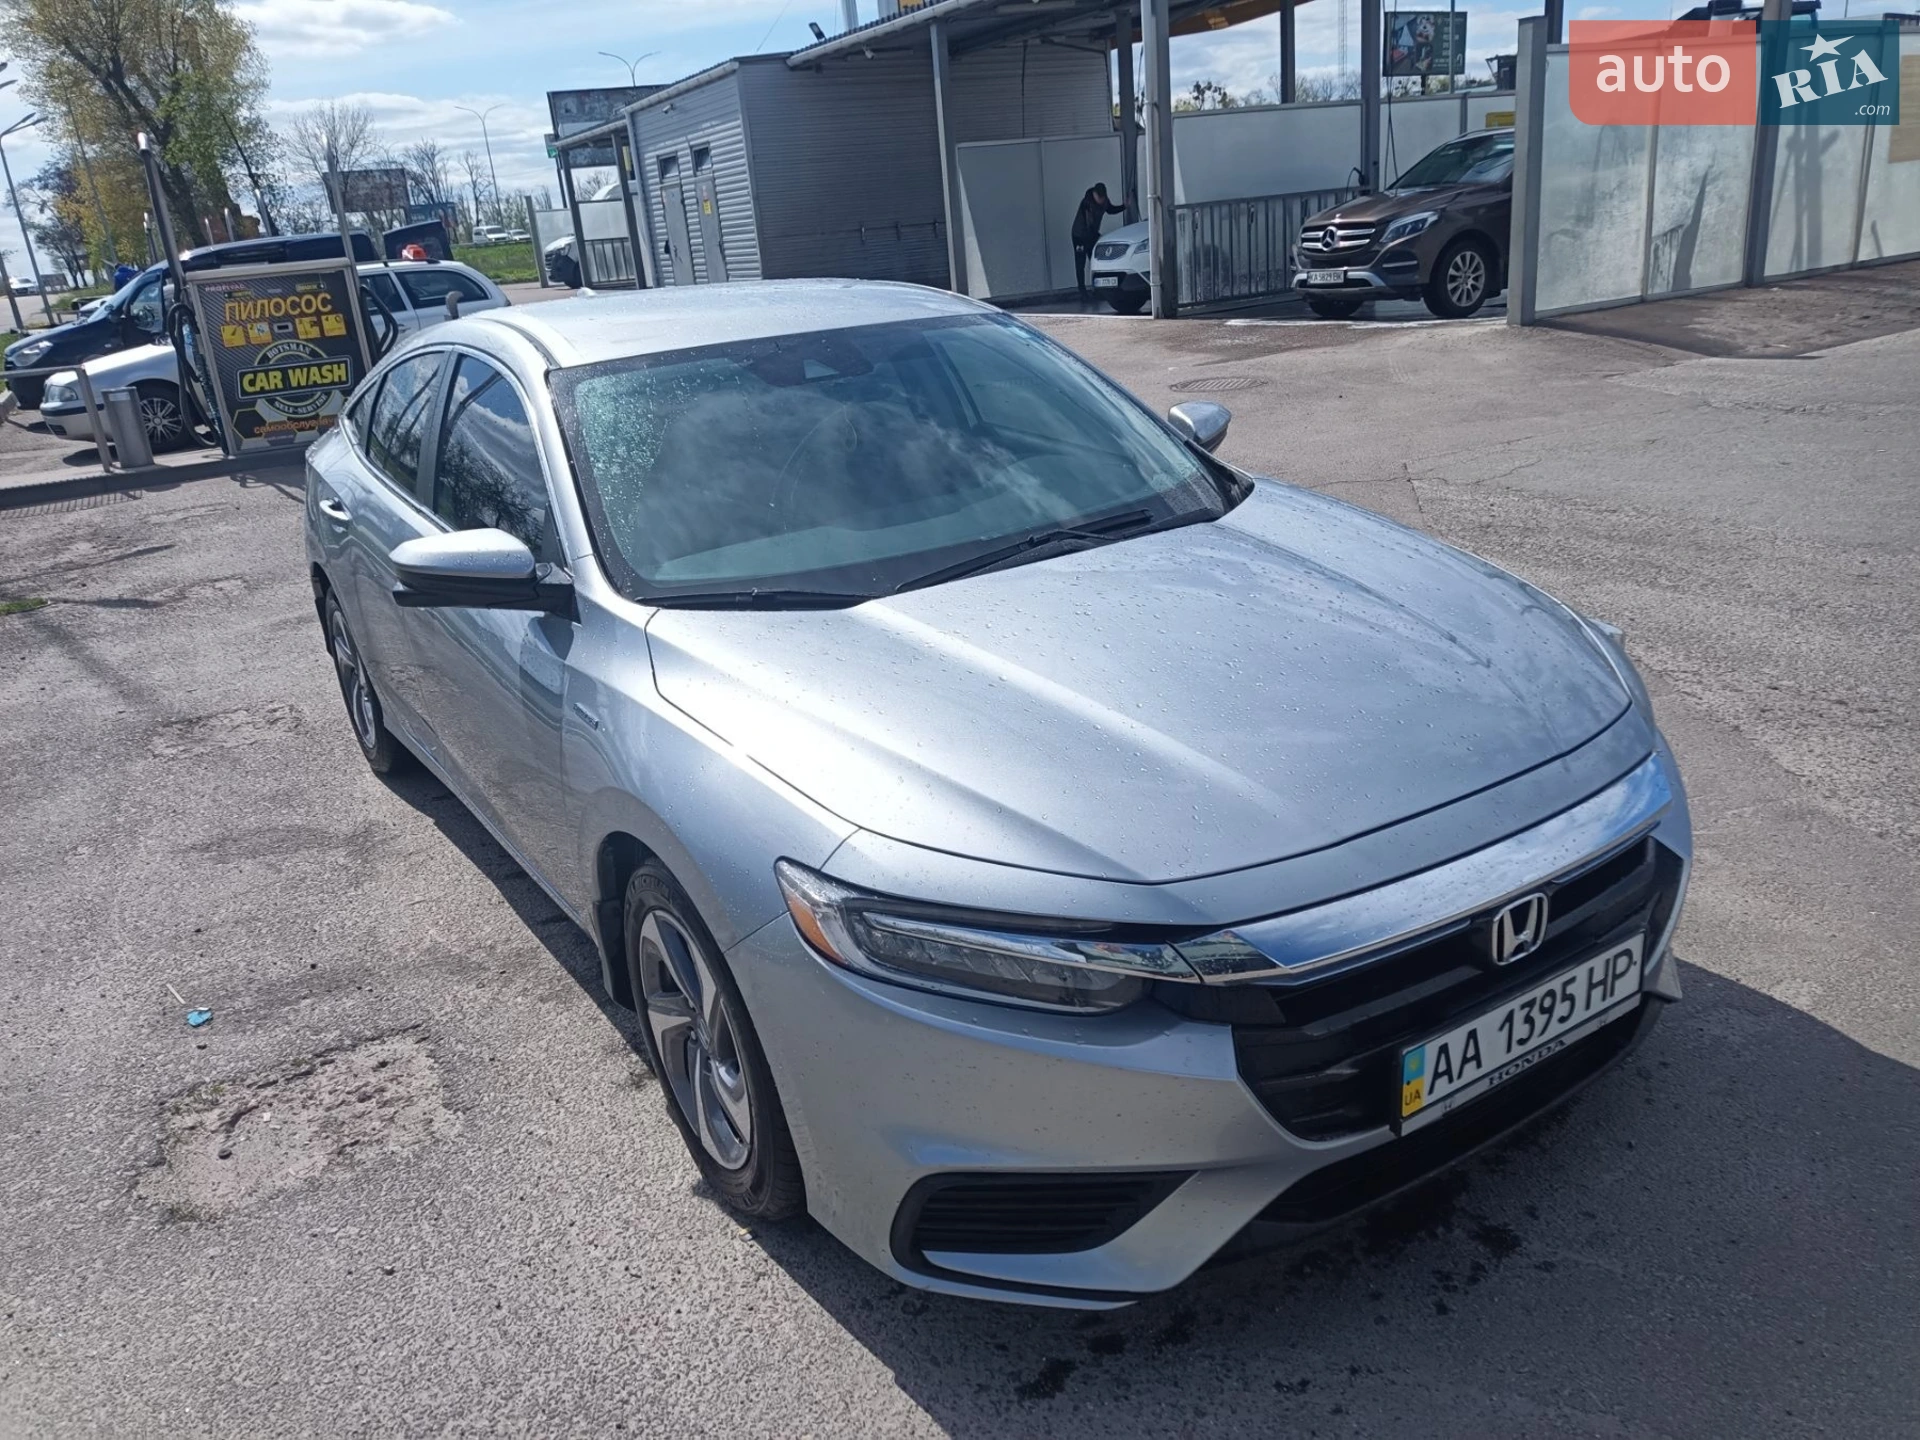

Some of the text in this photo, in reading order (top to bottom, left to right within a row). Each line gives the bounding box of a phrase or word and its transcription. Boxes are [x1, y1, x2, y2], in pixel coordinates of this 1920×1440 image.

[225, 293, 332, 322] ПИЛОСОС
[242, 363, 347, 393] CAR WASH
[1428, 948, 1634, 1096] AA 1395 HP
[1487, 1039, 1567, 1087] HONDA
[1405, 1088, 1422, 1107] UA
